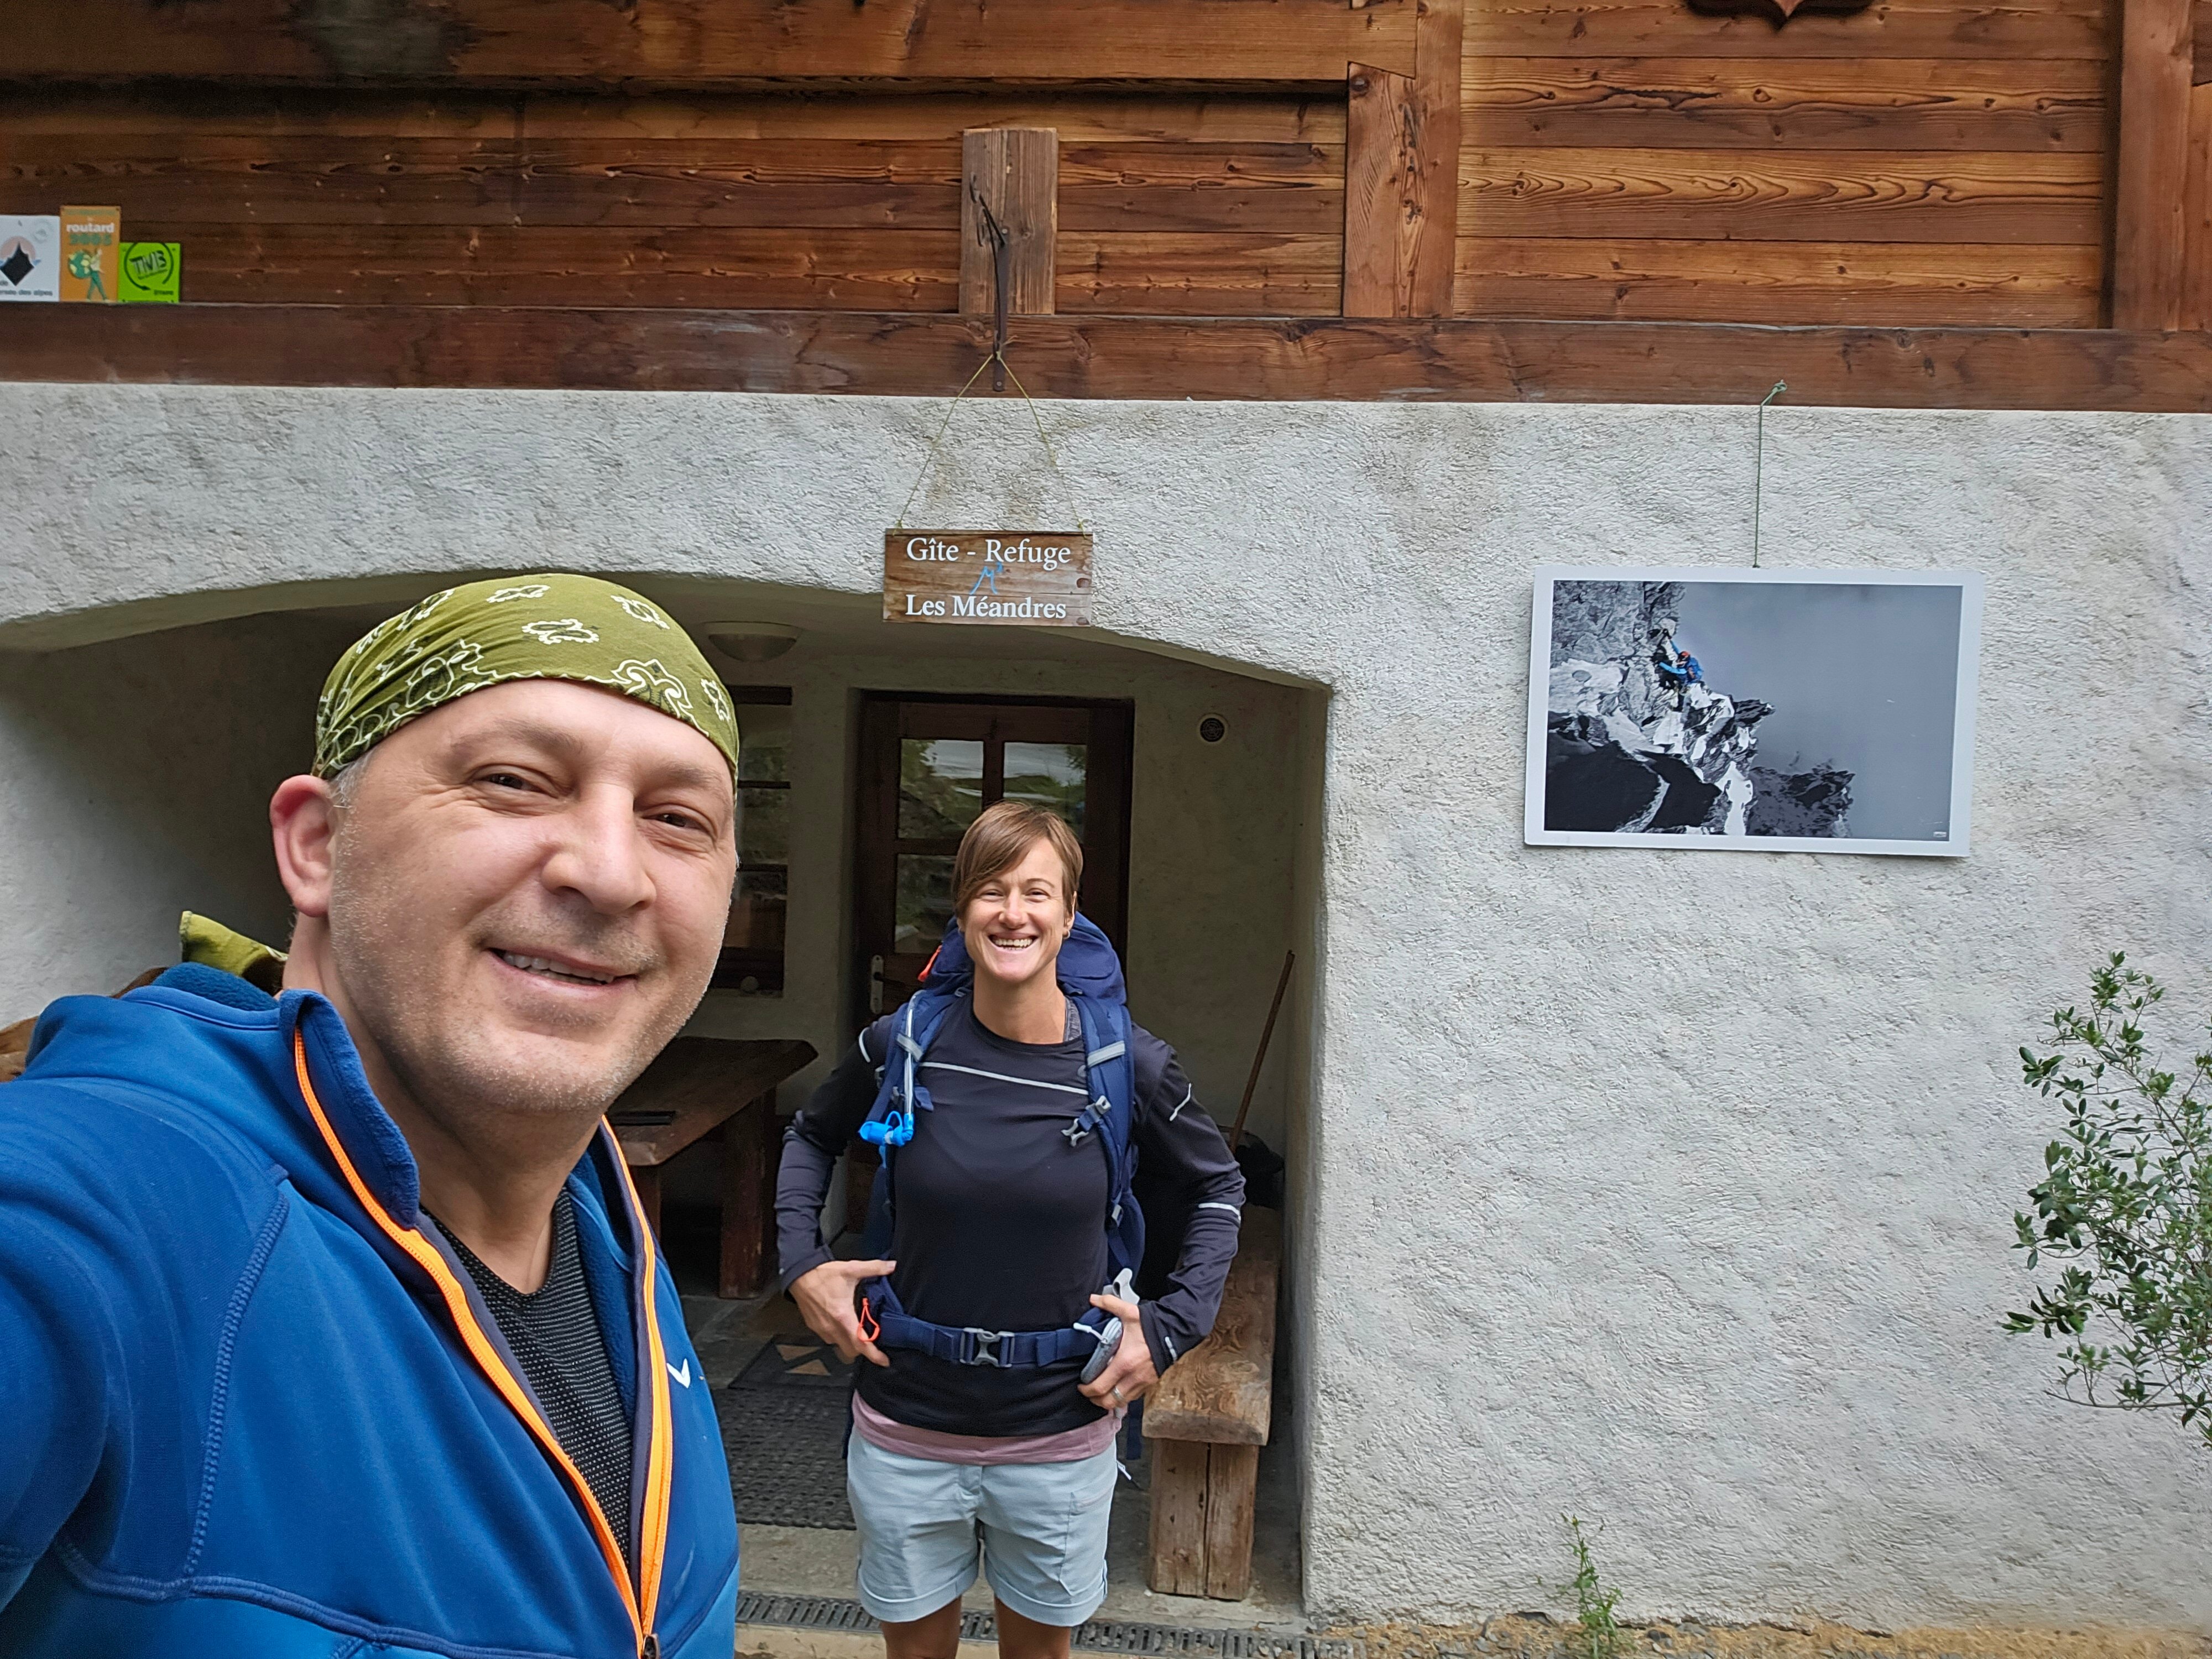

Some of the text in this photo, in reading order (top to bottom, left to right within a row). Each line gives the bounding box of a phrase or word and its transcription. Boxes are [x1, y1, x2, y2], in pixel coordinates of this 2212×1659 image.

[66, 222, 114, 233] routard
[906, 538, 959, 561] Gîte
[984, 538, 1071, 571] Refuge
[905, 594, 1067, 619] Les Méandres
